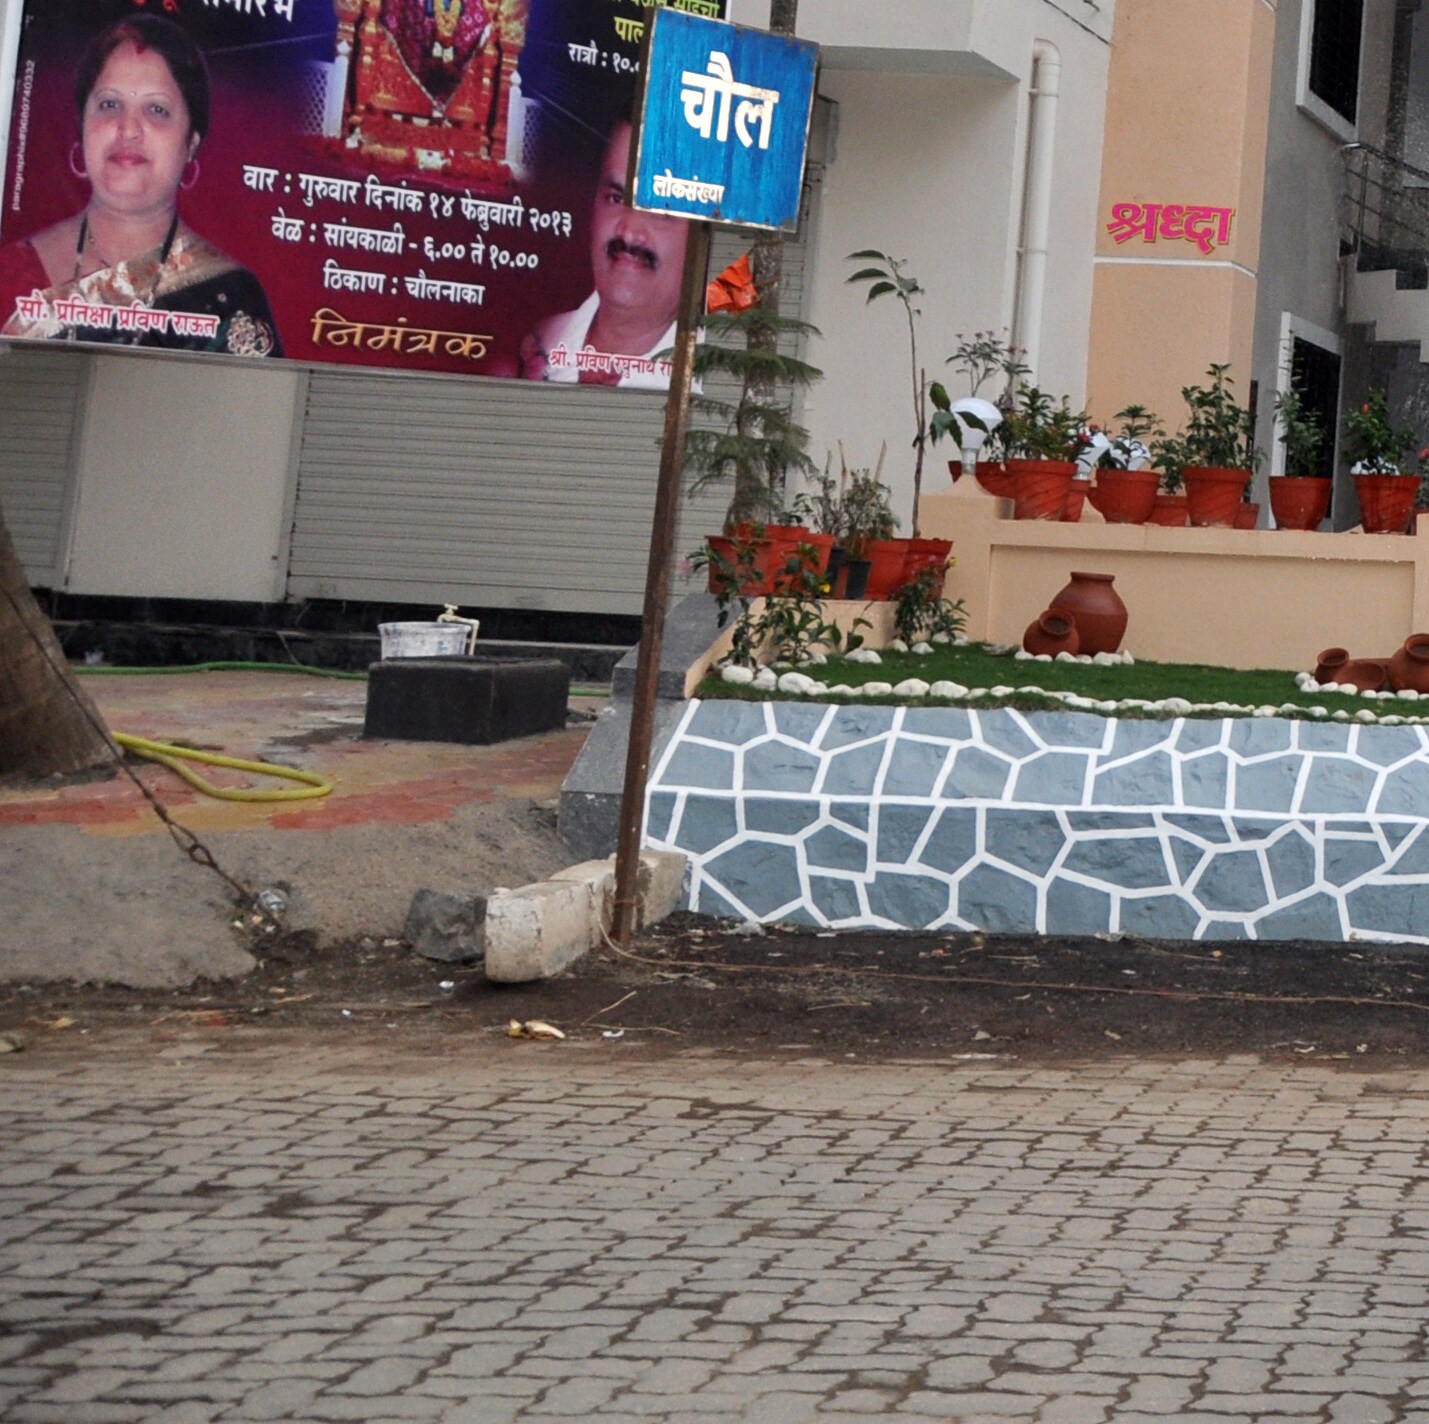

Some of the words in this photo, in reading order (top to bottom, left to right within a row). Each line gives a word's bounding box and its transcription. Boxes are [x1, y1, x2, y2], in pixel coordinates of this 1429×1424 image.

[680, 50, 780, 150] चौल
[243, 164, 278, 193] वार
[299, 173, 361, 207] गुरुवार
[365, 174, 425, 213] दिनांक
[429, 193, 455, 219] १४
[461, 189, 525, 231] फेब्रुवारी
[529, 209, 572, 237] २०१३
[652, 168, 725, 204] लोकसंख्या
[271, 207, 304, 242] वेळ
[323, 217, 405, 255] सांयकाळी
[470, 235, 484, 265] ते
[323, 258, 385, 294] ठिकाण
[405, 269, 485, 306] चौलनाका
[54, 294, 114, 326] प्रतिक्षा
[117, 299, 169, 332] प्रविण
[172, 308, 221, 338] राऊत
[311, 308, 493, 359] निमंत्रक
